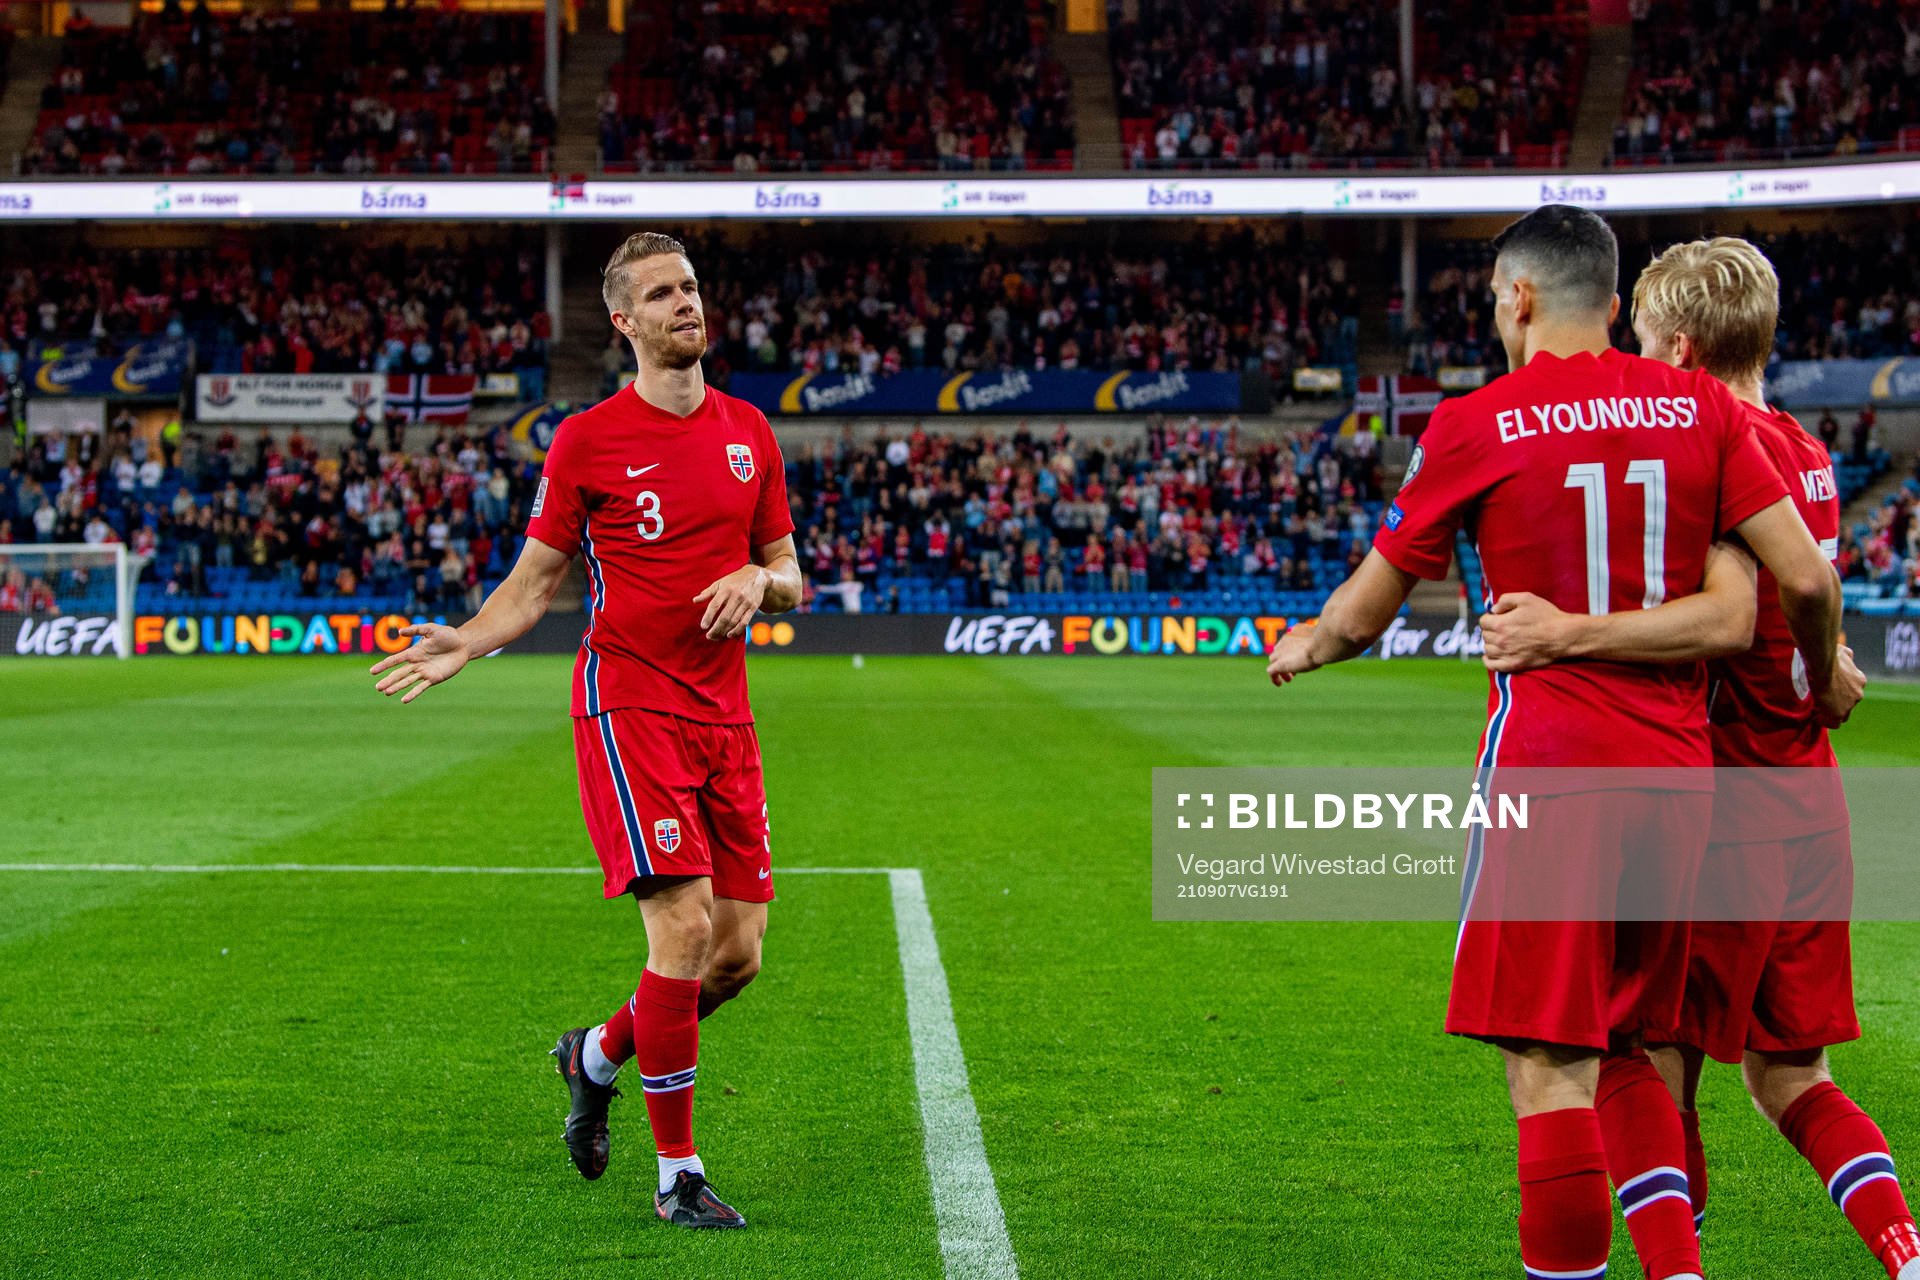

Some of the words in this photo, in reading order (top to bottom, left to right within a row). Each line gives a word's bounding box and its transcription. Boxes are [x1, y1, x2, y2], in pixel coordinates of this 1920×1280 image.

[636, 490, 665, 541] 3
[1563, 458, 1667, 616] 11
[15, 615, 120, 655] UEFA
[135, 615, 447, 655] FOUNDATIO
[944, 615, 1056, 654] UEFA
[1062, 615, 1320, 655] FOUNDAT
[1380, 616, 1430, 661] for
